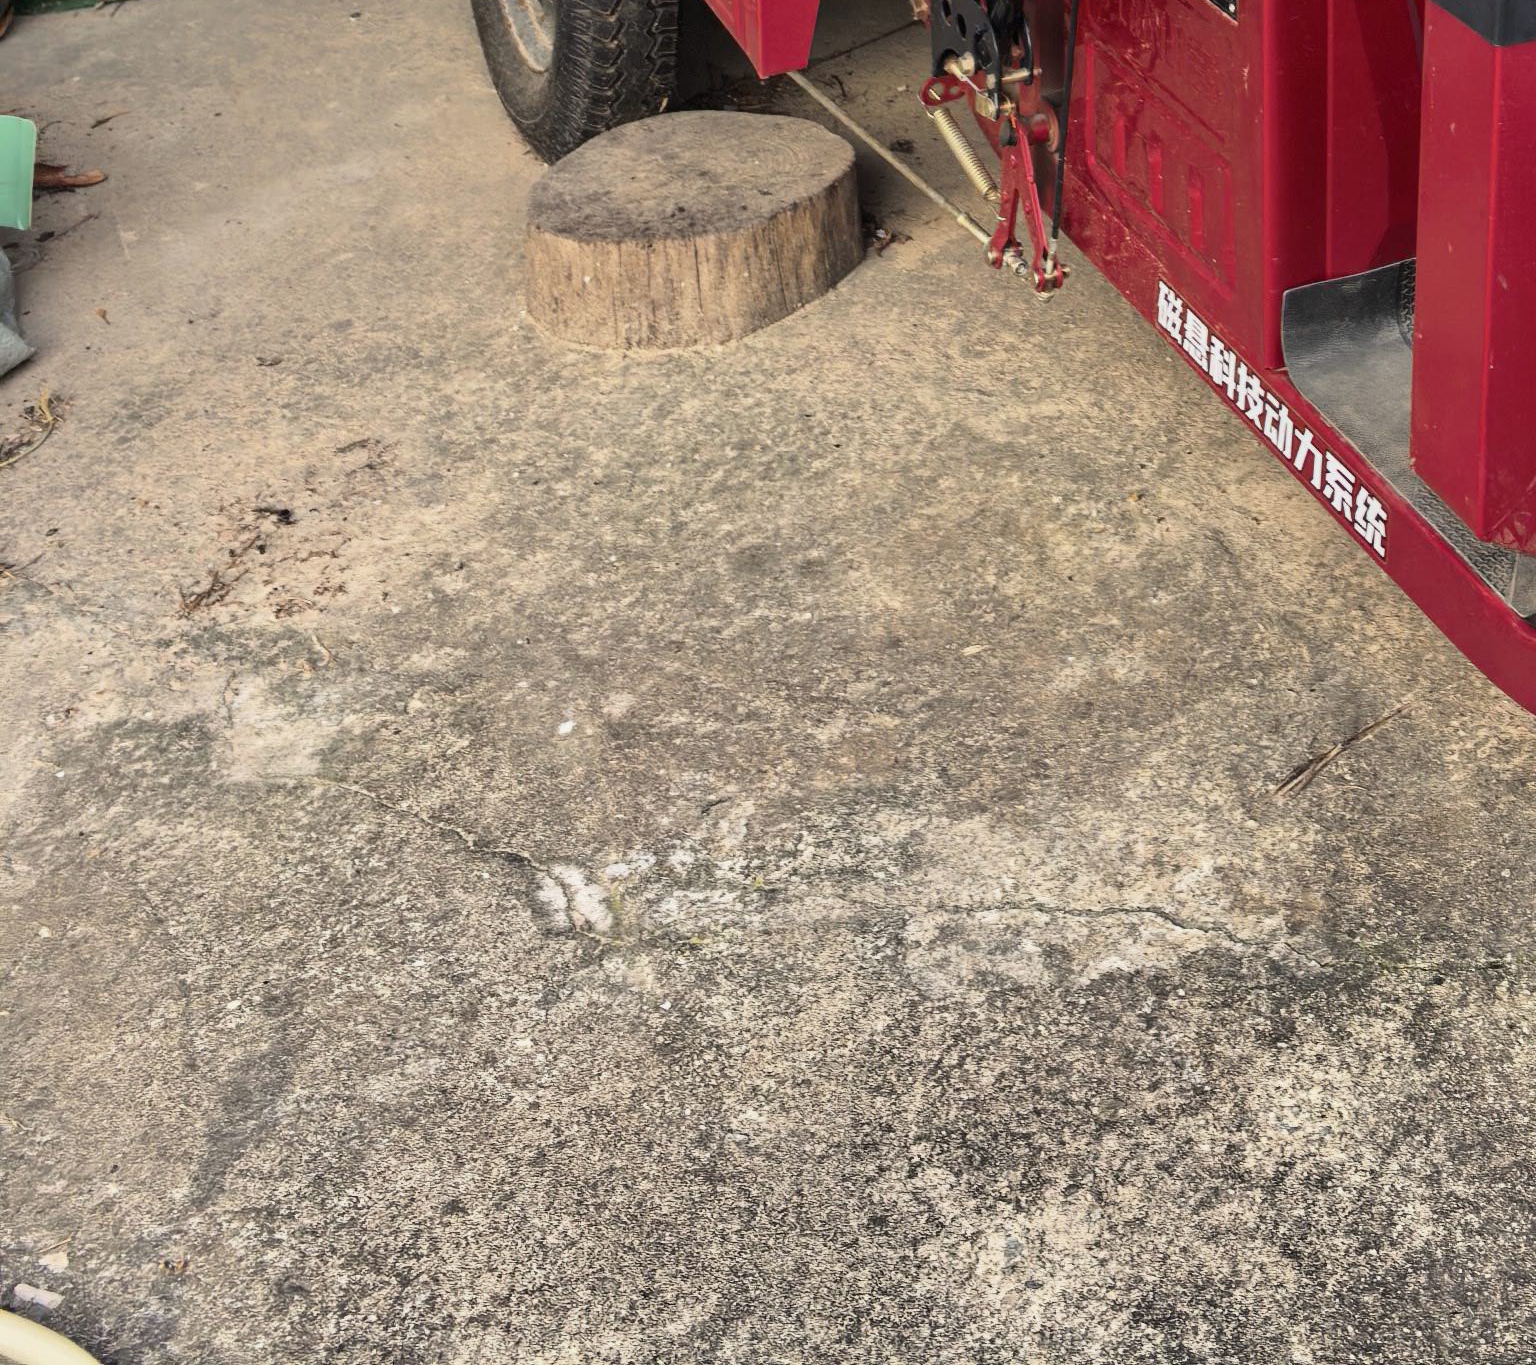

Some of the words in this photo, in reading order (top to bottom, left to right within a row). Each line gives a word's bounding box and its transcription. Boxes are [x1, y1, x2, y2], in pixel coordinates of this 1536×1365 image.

[1157, 280, 1388, 557] 磁悬科技动力系统
